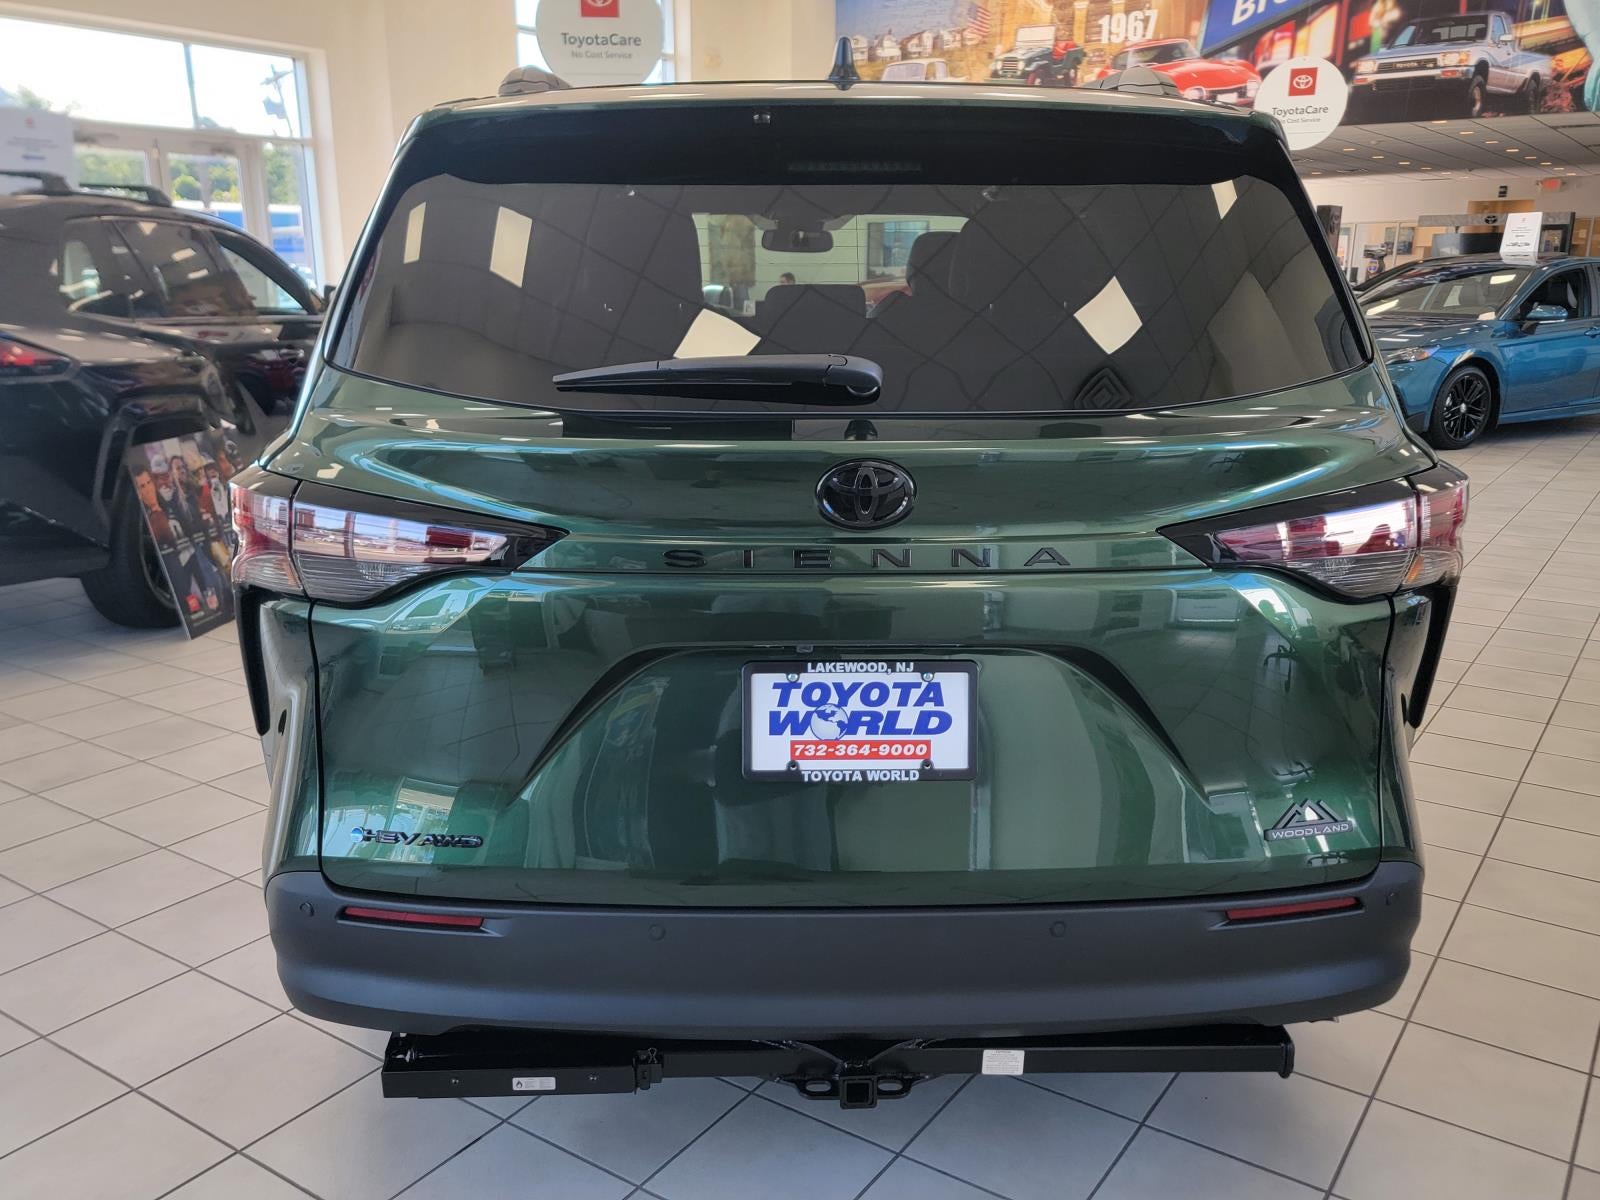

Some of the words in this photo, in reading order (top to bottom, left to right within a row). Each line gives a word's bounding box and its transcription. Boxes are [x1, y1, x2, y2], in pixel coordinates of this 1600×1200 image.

[1098, 9, 1158, 43] 1967
[560, 32, 642, 48] ToyotaCare
[605, 51, 632, 59] Service
[1271, 105, 1329, 118] ToyotaCare
[663, 548, 1072, 569] SIENNA
[807, 662, 892, 674] LAKEWOOD,
[896, 662, 914, 673] NJ
[772, 681, 945, 707] TOYOTA
[794, 744, 928, 756] 732-364-9000
[801, 770, 863, 782] TOYOTA
[867, 770, 920, 781] WORLD
[1271, 823, 1349, 839] WOODLAND
